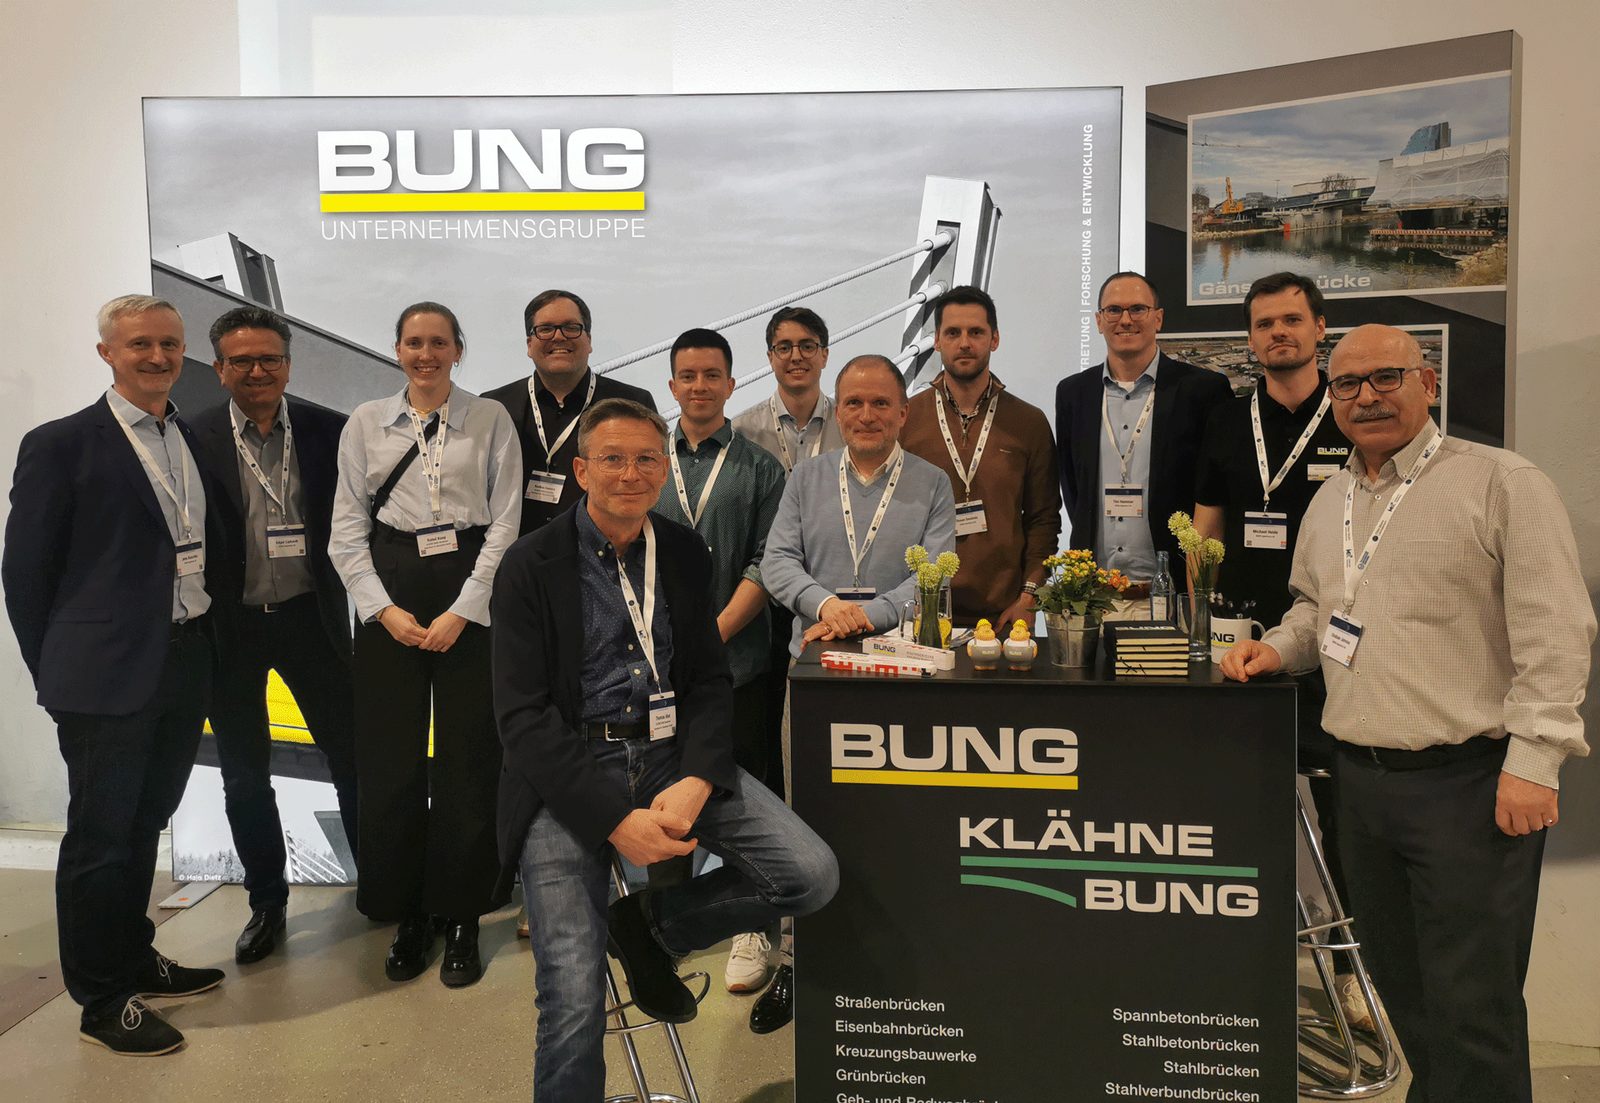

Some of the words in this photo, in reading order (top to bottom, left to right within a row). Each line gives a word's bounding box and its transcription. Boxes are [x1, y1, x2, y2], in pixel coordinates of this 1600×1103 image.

[317, 128, 645, 192] BUNG
[1082, 124, 1093, 214] ENTWICKLUNG
[321, 218, 646, 241] UNTERNEHMENSGRUPPE
[1082, 218, 1092, 227] &
[1082, 231, 1092, 306] FORSCHUNG
[1211, 632, 1235, 643] NG
[873, 643, 896, 653] BUNG
[830, 723, 1078, 775] BUNG
[960, 809, 1214, 858] KLÄHNE
[1084, 878, 1259, 917] BUNG
[835, 995, 945, 1012] Straßenbrücken
[1112, 1008, 1260, 1028] Spannbetonbrücken
[835, 1019, 964, 1038] Eisenbahnbrücken
[1122, 1033, 1260, 1053] Stahlbetonbrücken
[836, 1044, 977, 1063] Kreuzungsbauwerke
[836, 1068, 926, 1085] Grünbrücken
[1163, 1060, 1260, 1078] Stahlbrücken
[836, 1093, 870, 1103] Geh-
[1105, 1083, 1260, 1103] Stahlverbundbrücken
